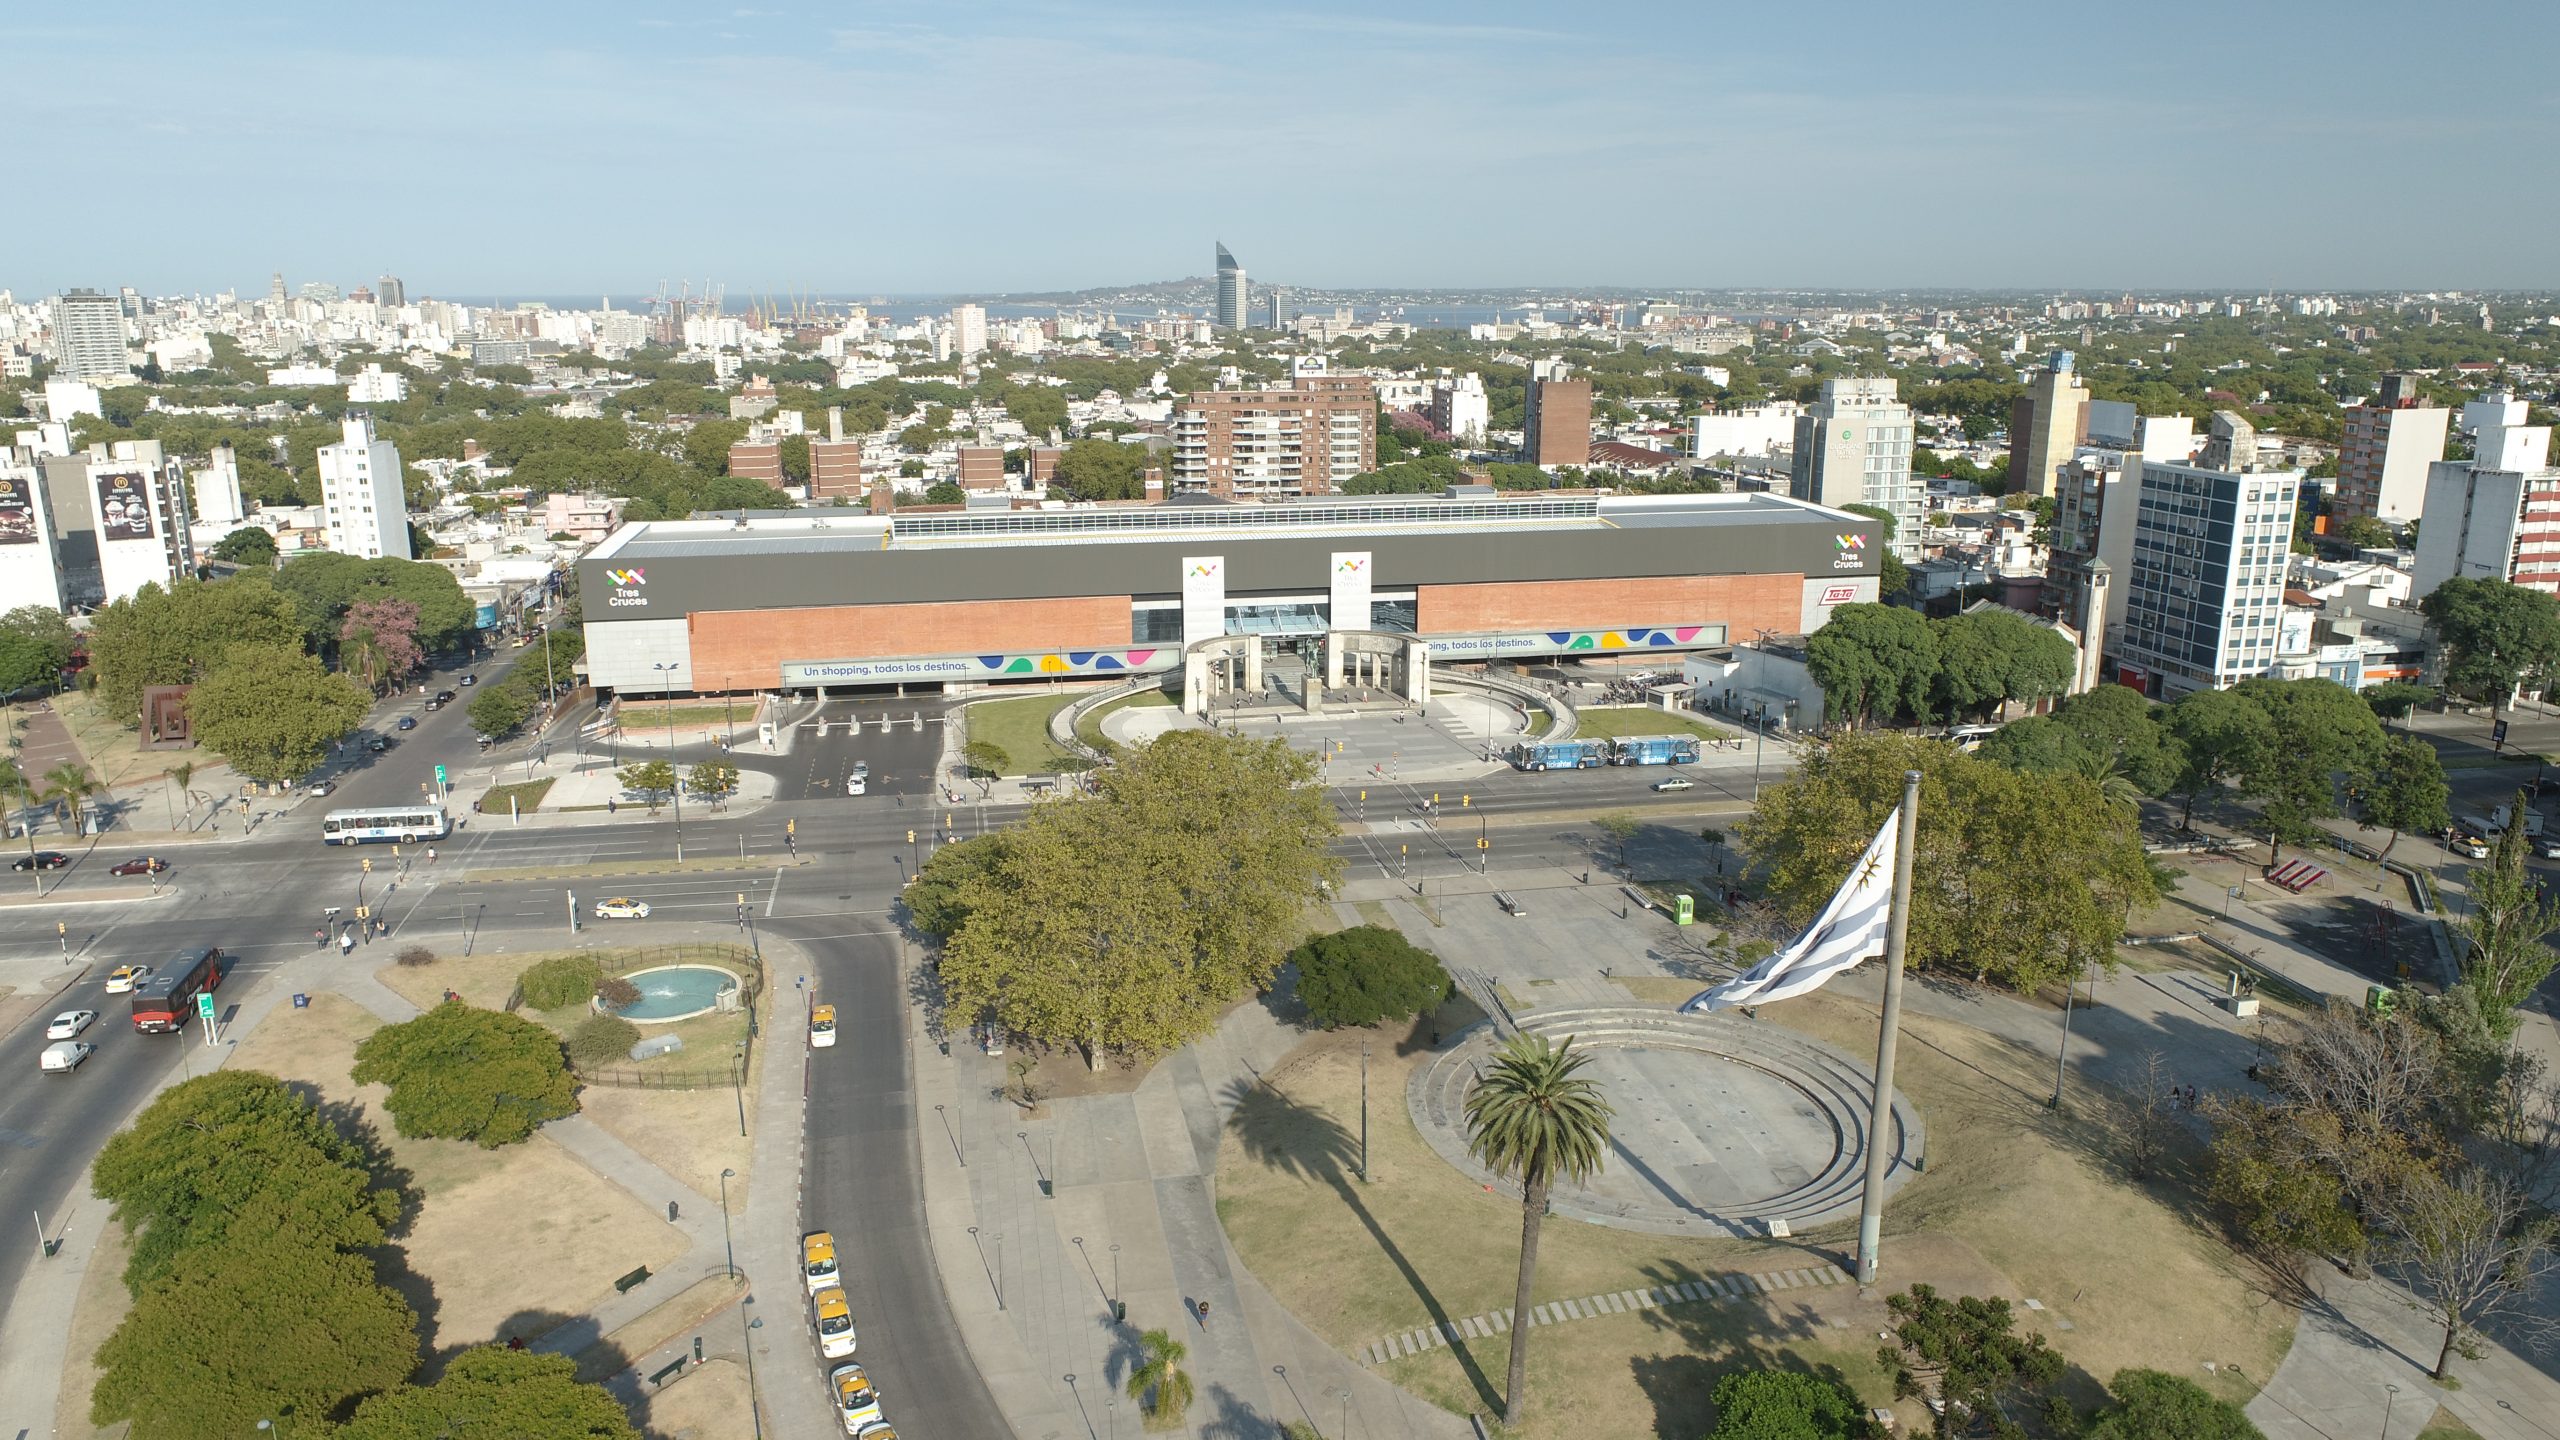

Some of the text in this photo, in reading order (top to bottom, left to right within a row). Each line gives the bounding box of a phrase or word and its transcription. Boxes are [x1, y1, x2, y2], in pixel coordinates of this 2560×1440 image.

[1840, 552, 1858, 560] Tres
[1833, 560, 1863, 568] Cruces
[616, 588, 639, 597] Tres
[609, 597, 648, 606] Cruces
[1452, 640, 1477, 649] todos
[1480, 639, 1493, 648] los
[1496, 638, 1536, 647] destinos.
[804, 667, 819, 676] Un
[822, 665, 871, 676] shopping,
[875, 664, 904, 673] todos
[906, 663, 921, 672] los
